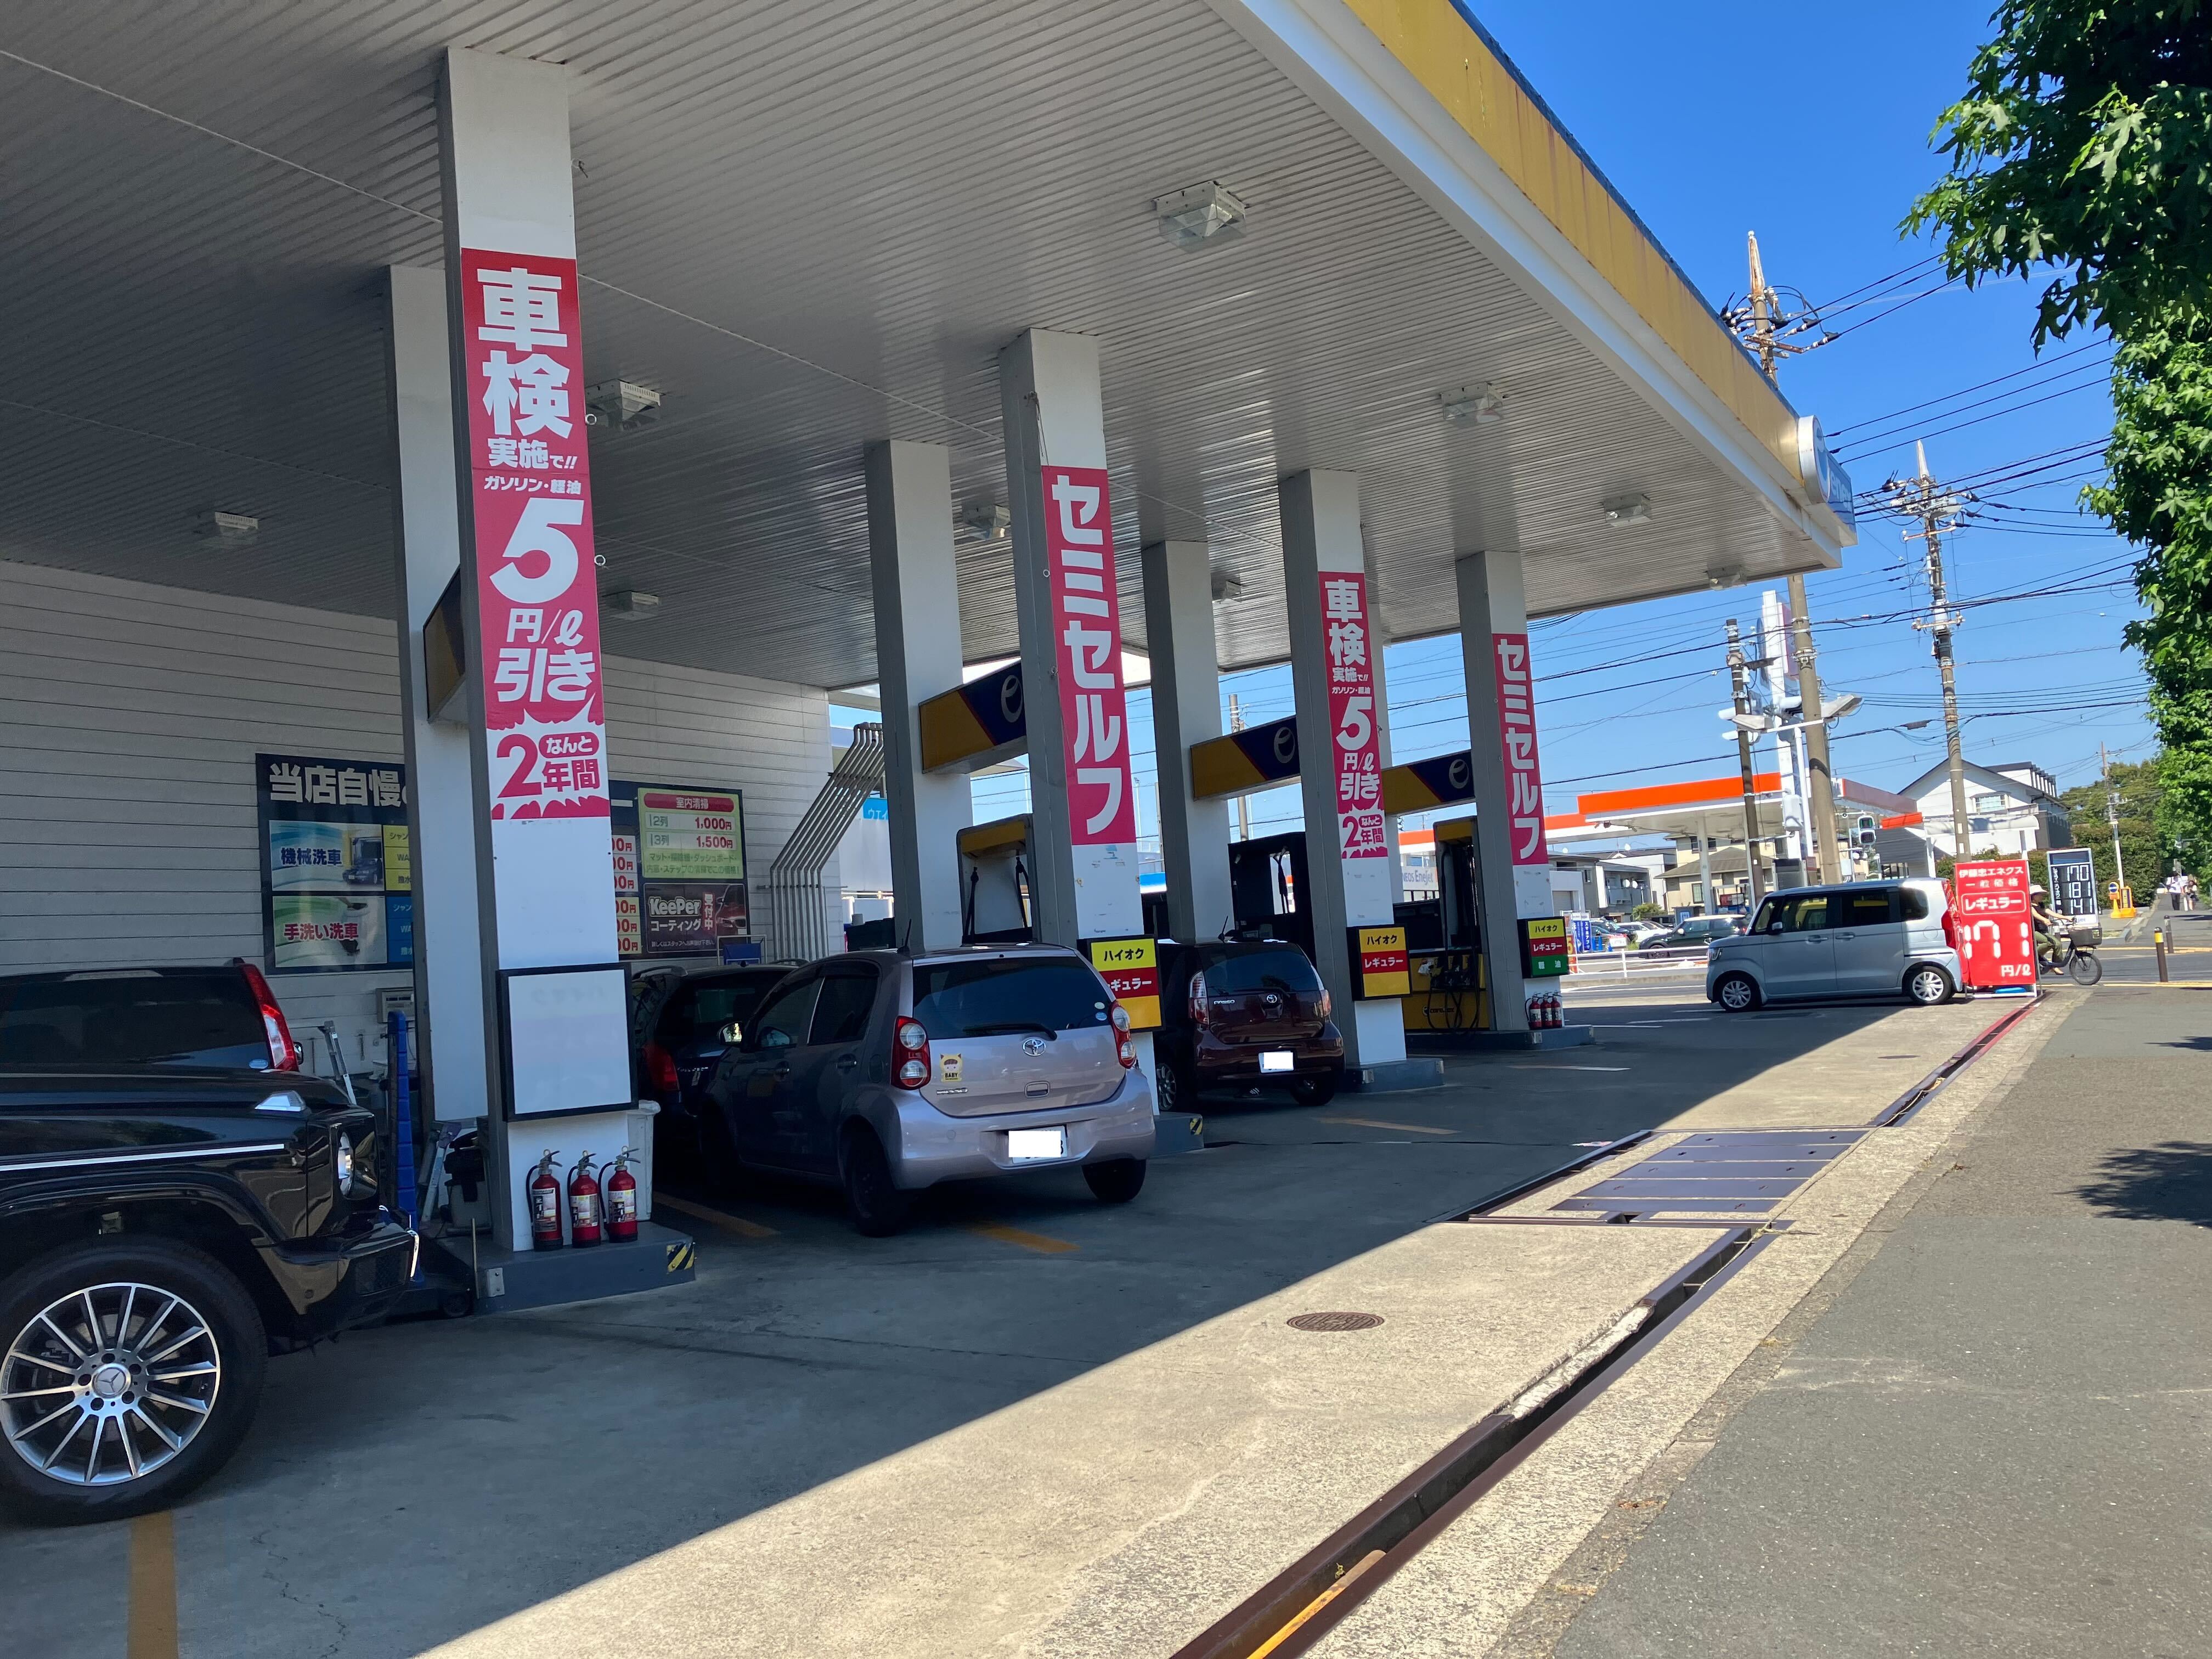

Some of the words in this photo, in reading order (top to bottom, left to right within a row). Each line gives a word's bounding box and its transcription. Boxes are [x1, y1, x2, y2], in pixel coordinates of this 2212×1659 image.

[477, 267, 573, 438] 車検
[488, 438, 578, 470] 実施で!!
[484, 476, 582, 494] ガソリン・軽油
[489, 498, 584, 603] 5
[1325, 579, 1367, 666] 車検
[1052, 475, 1122, 836] セミセルフ
[494, 647, 595, 702] 引き
[1336, 697, 1372, 751] 5
[546, 735, 594, 754] なんと
[1497, 639, 1540, 860] セミセルフ
[1340, 772, 1380, 800] 引き
[676, 797, 709, 809] 室内清掃
[695, 817, 732, 830] 1,000円
[1361, 816, 1381, 826] なんと
[697, 836, 733, 849] 1,500円
[281, 848, 342, 866] 機械洗車
[1959, 866, 2024, 878] 伊藤忠エネクス
[2067, 865, 2089, 881] 170
[2069, 882, 2090, 898] 181
[649, 897, 701, 916] KeePer
[1965, 896, 2022, 911] レギュラー
[2070, 898, 2092, 914] 141
[284, 923, 358, 940] 手洗い洗車
[651, 919, 701, 932] コーティング
[1367, 934, 1397, 945] ハイオク
[1533, 943, 1562, 952] レギュラー
[1964, 920, 2029, 959] 171
[1104, 948, 1144, 961] ハイオク
[1364, 957, 1404, 968] レギュラー
[1108, 978, 1152, 991] ギュラー
